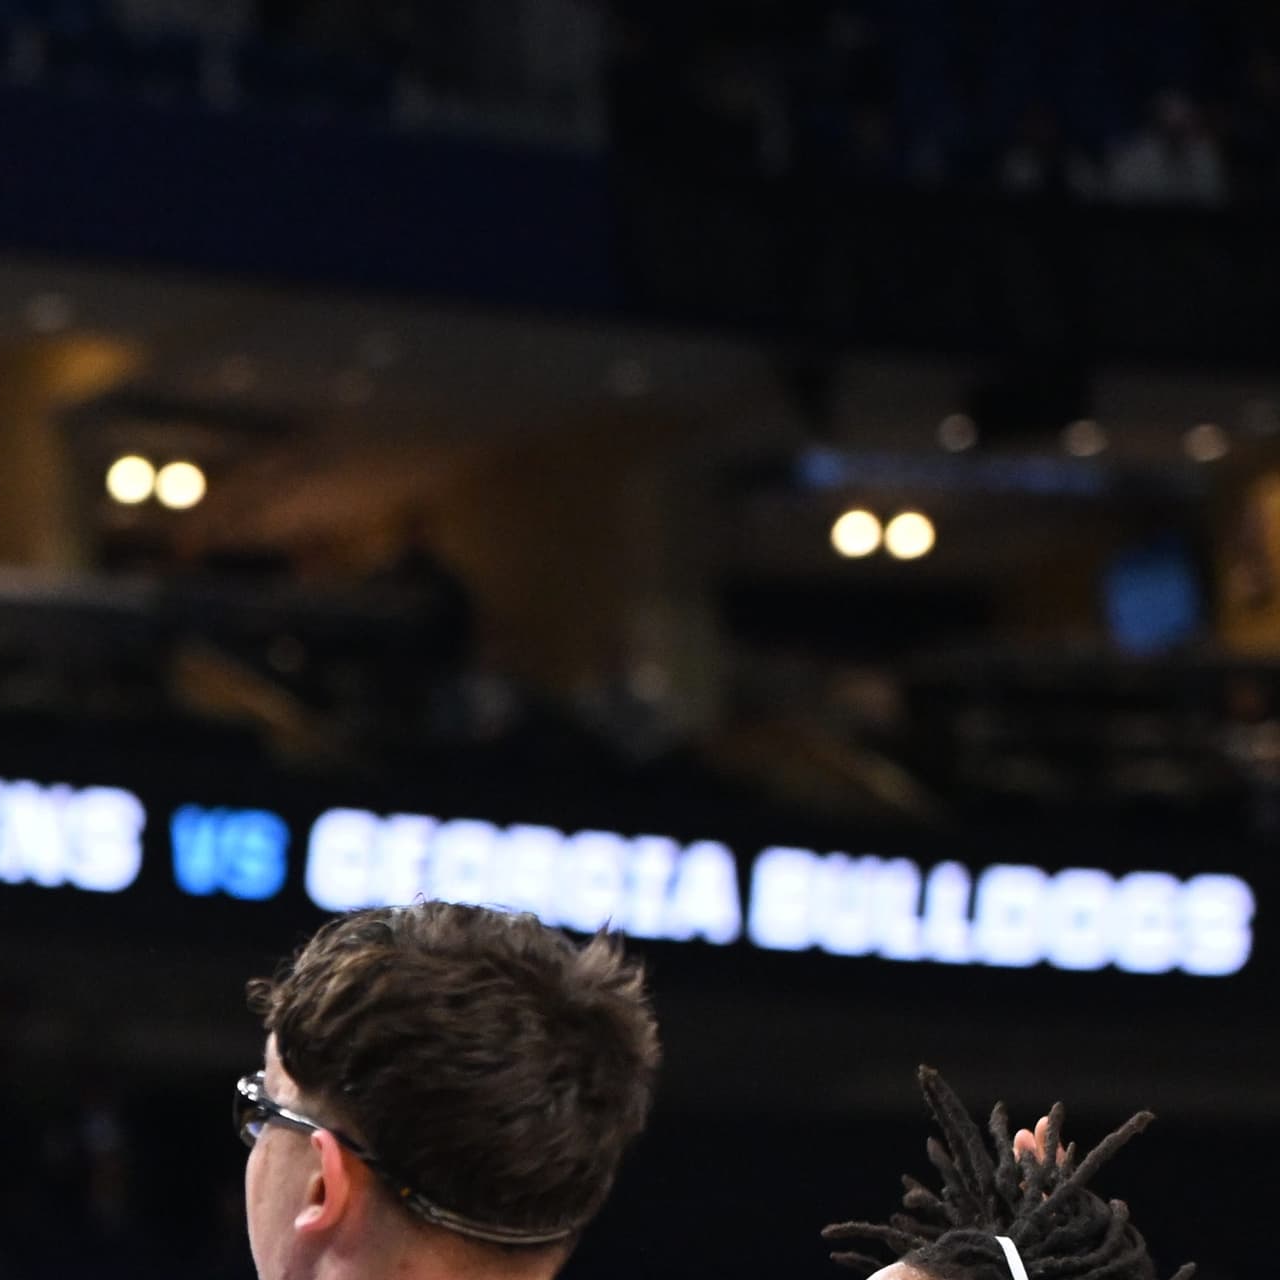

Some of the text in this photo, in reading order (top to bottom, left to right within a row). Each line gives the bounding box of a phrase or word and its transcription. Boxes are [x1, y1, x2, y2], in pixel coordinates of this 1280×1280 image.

[169, 803, 289, 900] VS
[305, 807, 741, 946] GEORGIA
[749, 845, 1256, 978] BULLDOGS
